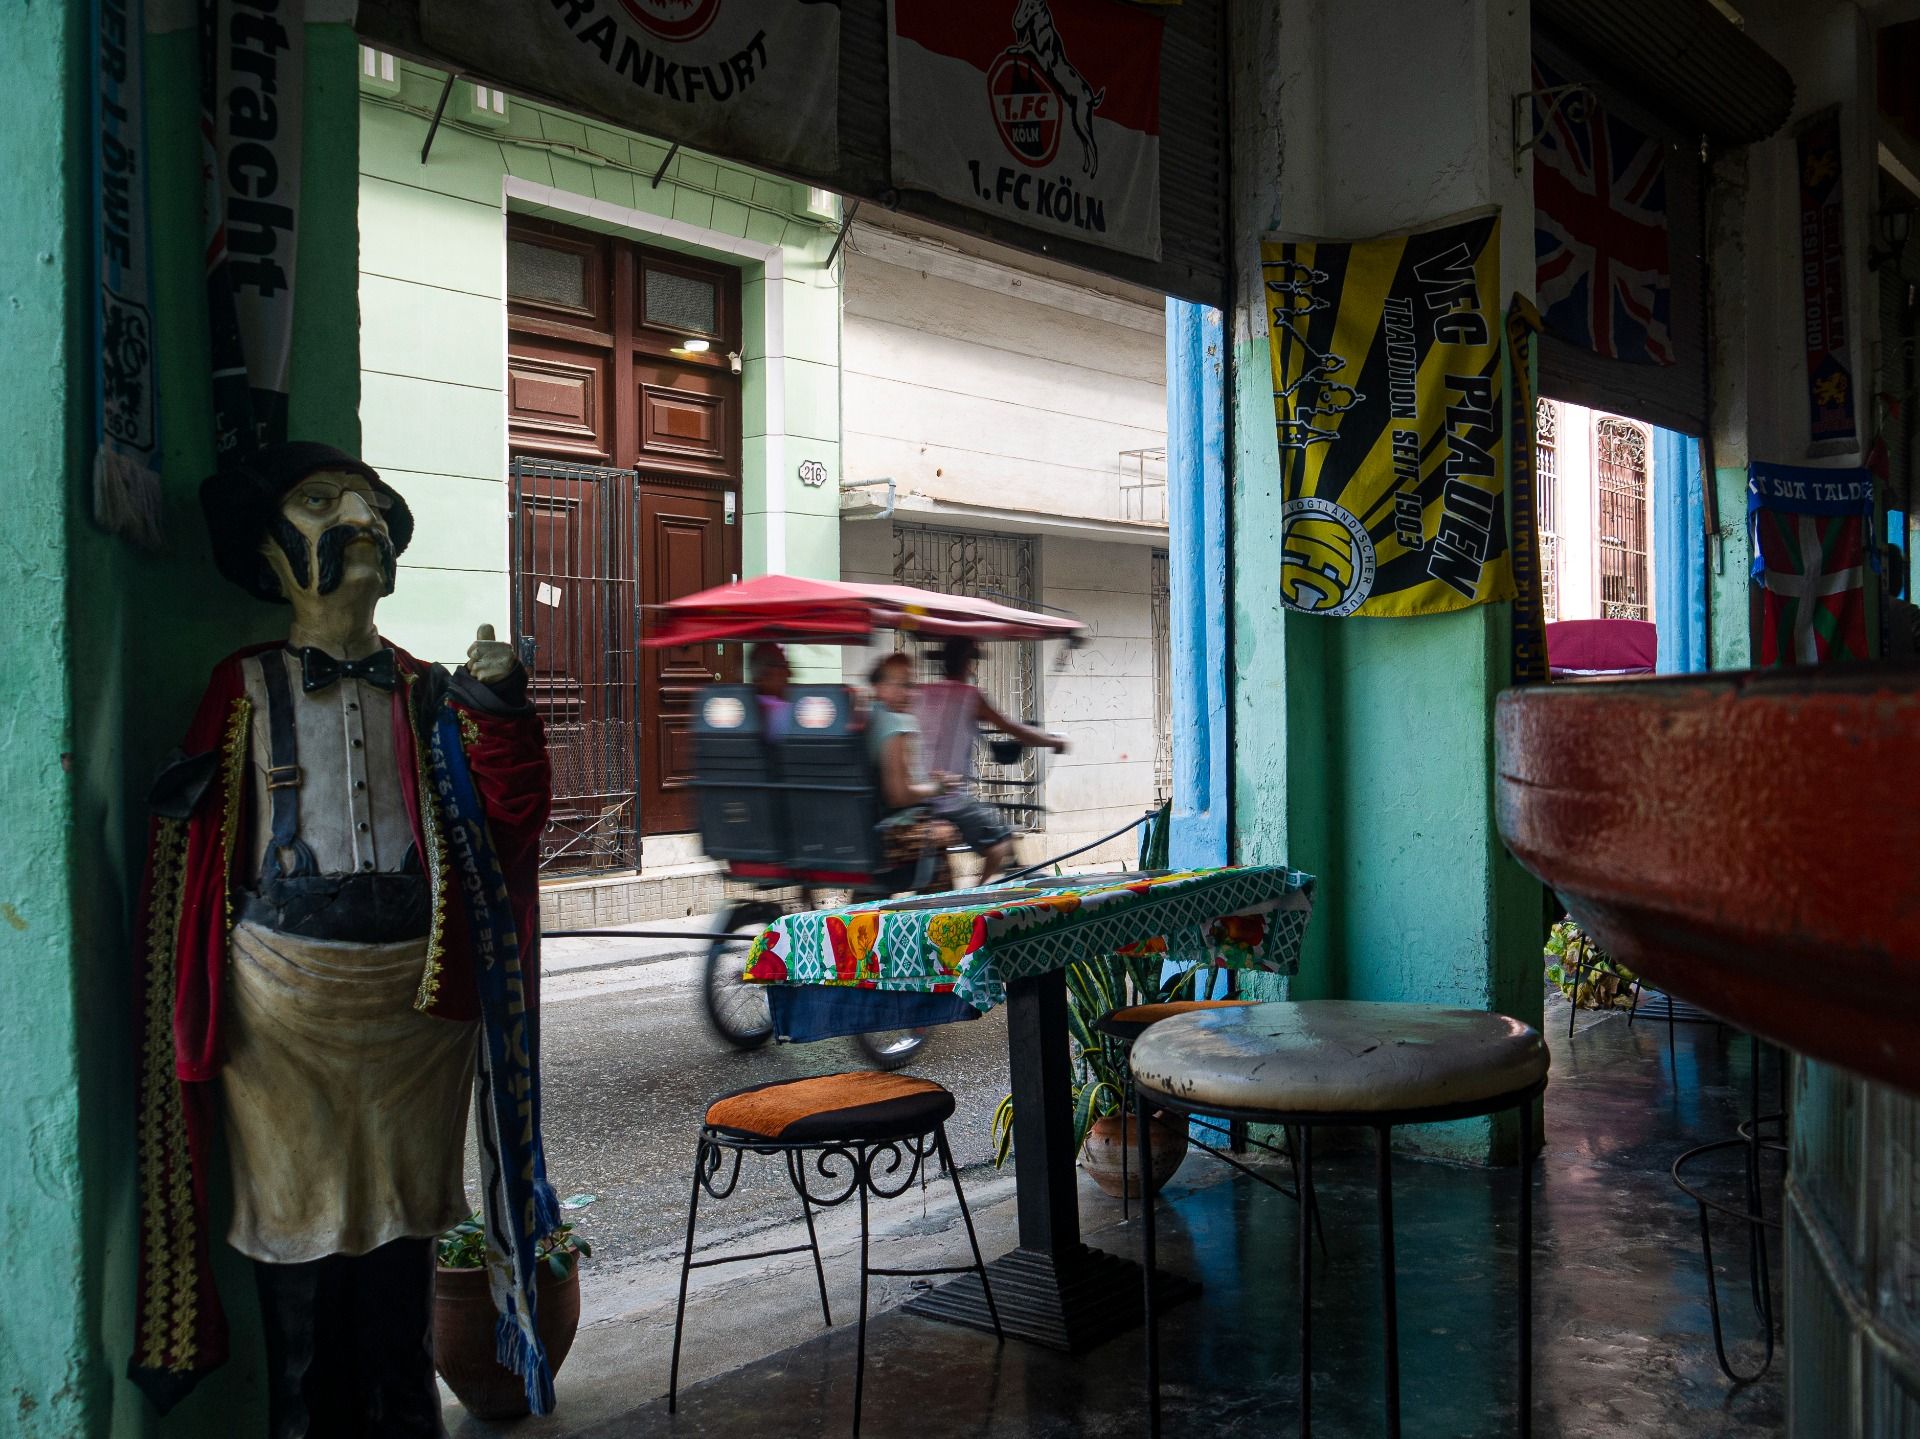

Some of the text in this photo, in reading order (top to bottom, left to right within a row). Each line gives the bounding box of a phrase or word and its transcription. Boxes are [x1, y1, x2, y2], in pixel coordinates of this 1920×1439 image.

[103, 0, 135, 269] ER LÖWE
[227, 0, 294, 298] tracht
[1012, 125, 1040, 143] KÖLN
[1037, 175, 1106, 232] KÖLN
[1384, 297, 1425, 551] TRADITION SEIT 1903
[1413, 242, 1496, 600] VFC PLAUEN
[804, 465, 822, 482] 216
[1774, 477, 1807, 499] SUA
[1281, 520, 1354, 610] VFC
